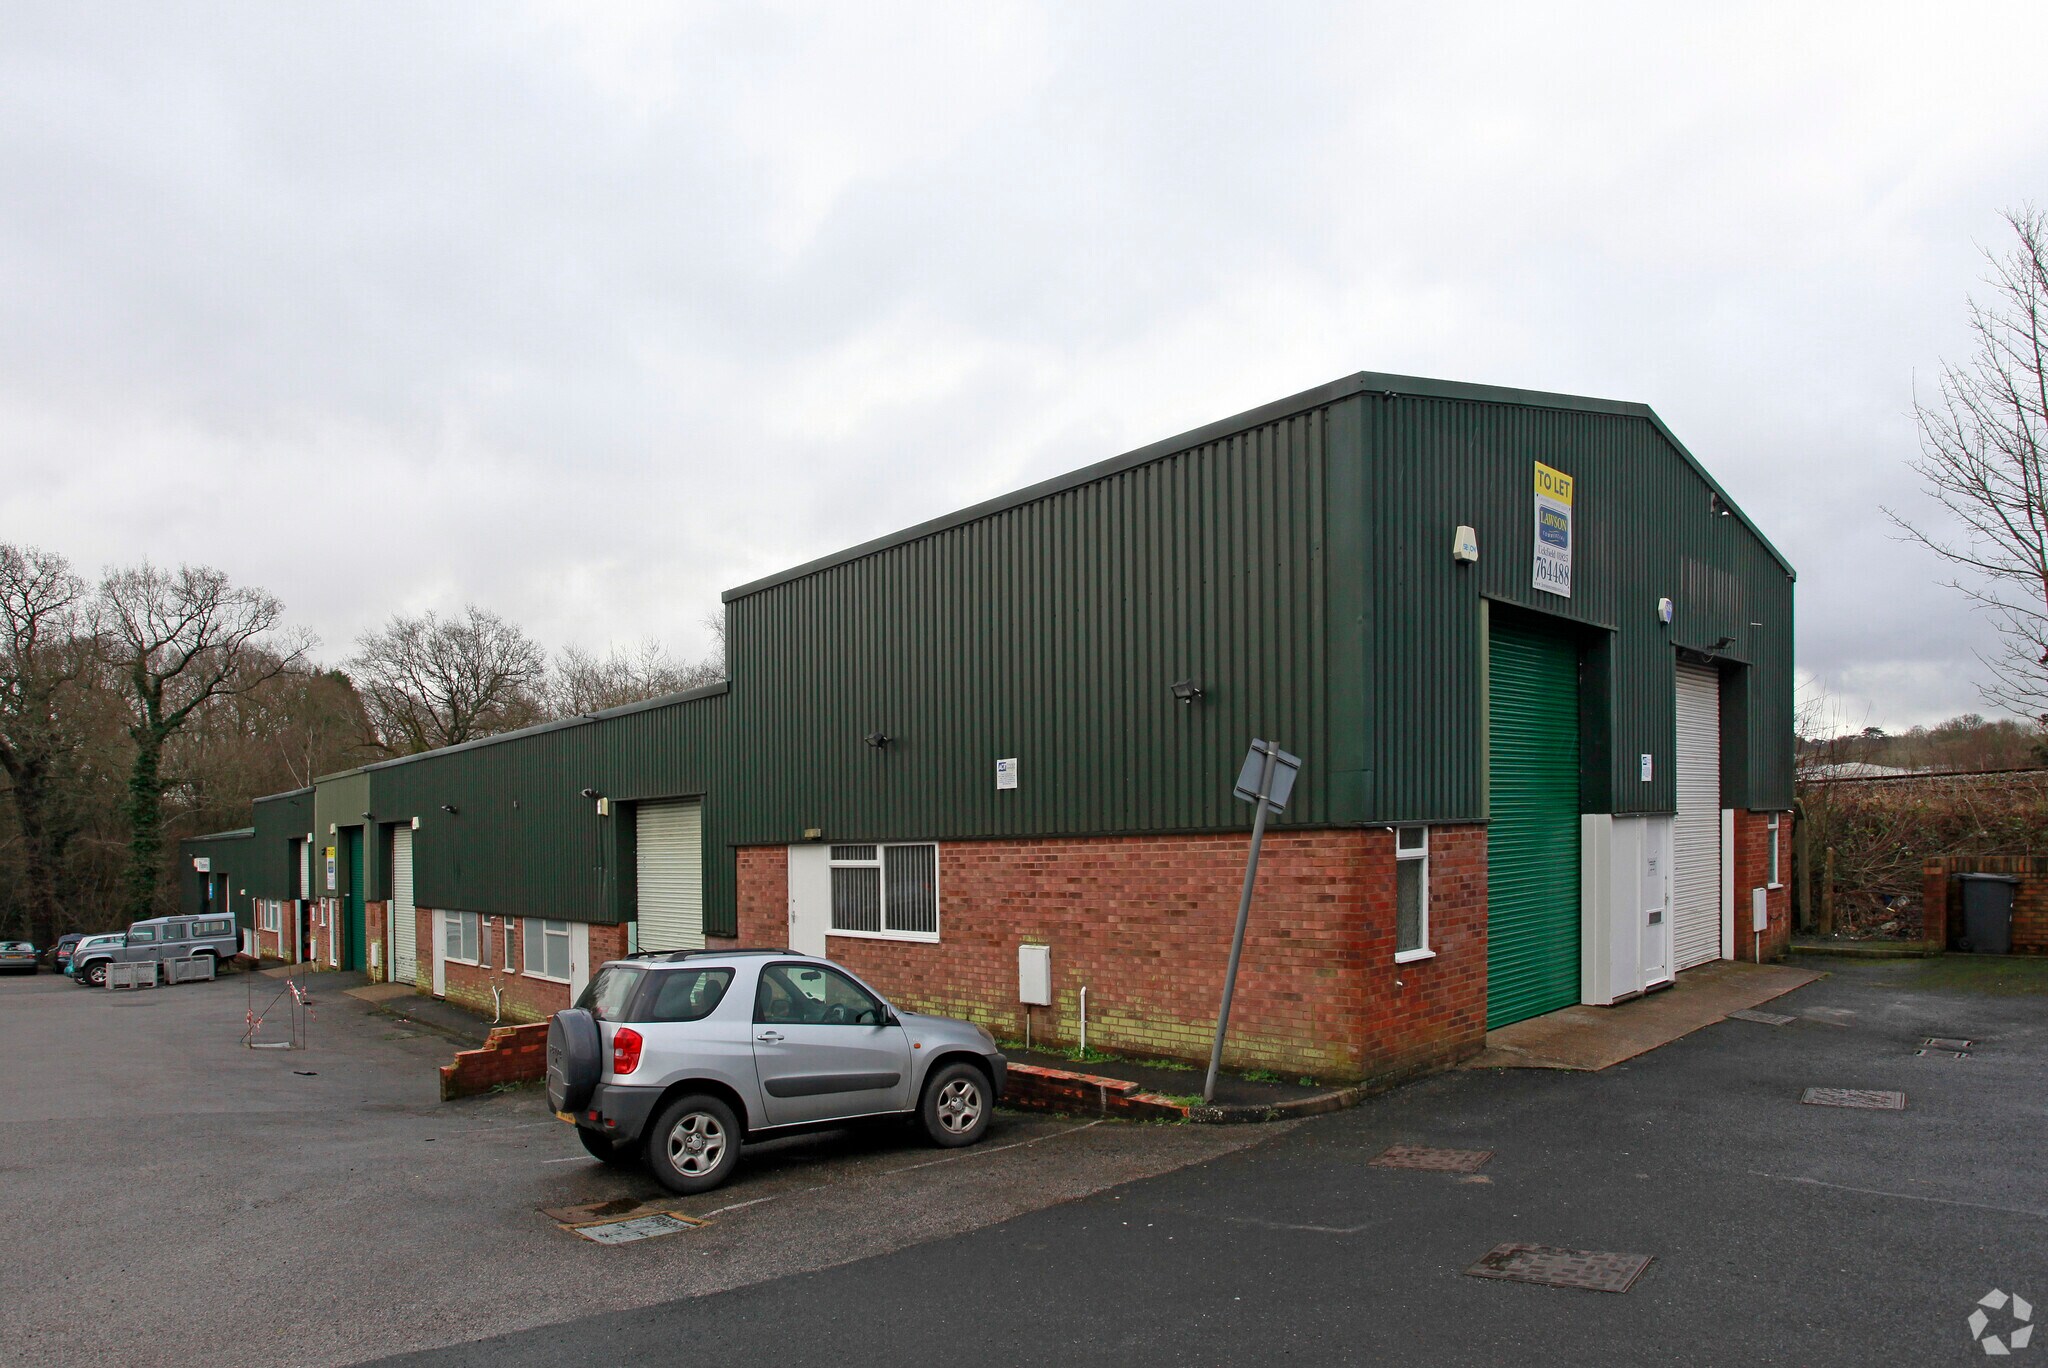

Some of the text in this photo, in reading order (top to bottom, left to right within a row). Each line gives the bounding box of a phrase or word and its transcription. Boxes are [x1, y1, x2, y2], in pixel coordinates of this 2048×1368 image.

[1537, 469, 1570, 498] TO LET
[1540, 510, 1567, 531] LAWSON
[1535, 556, 1569, 587] 764488
